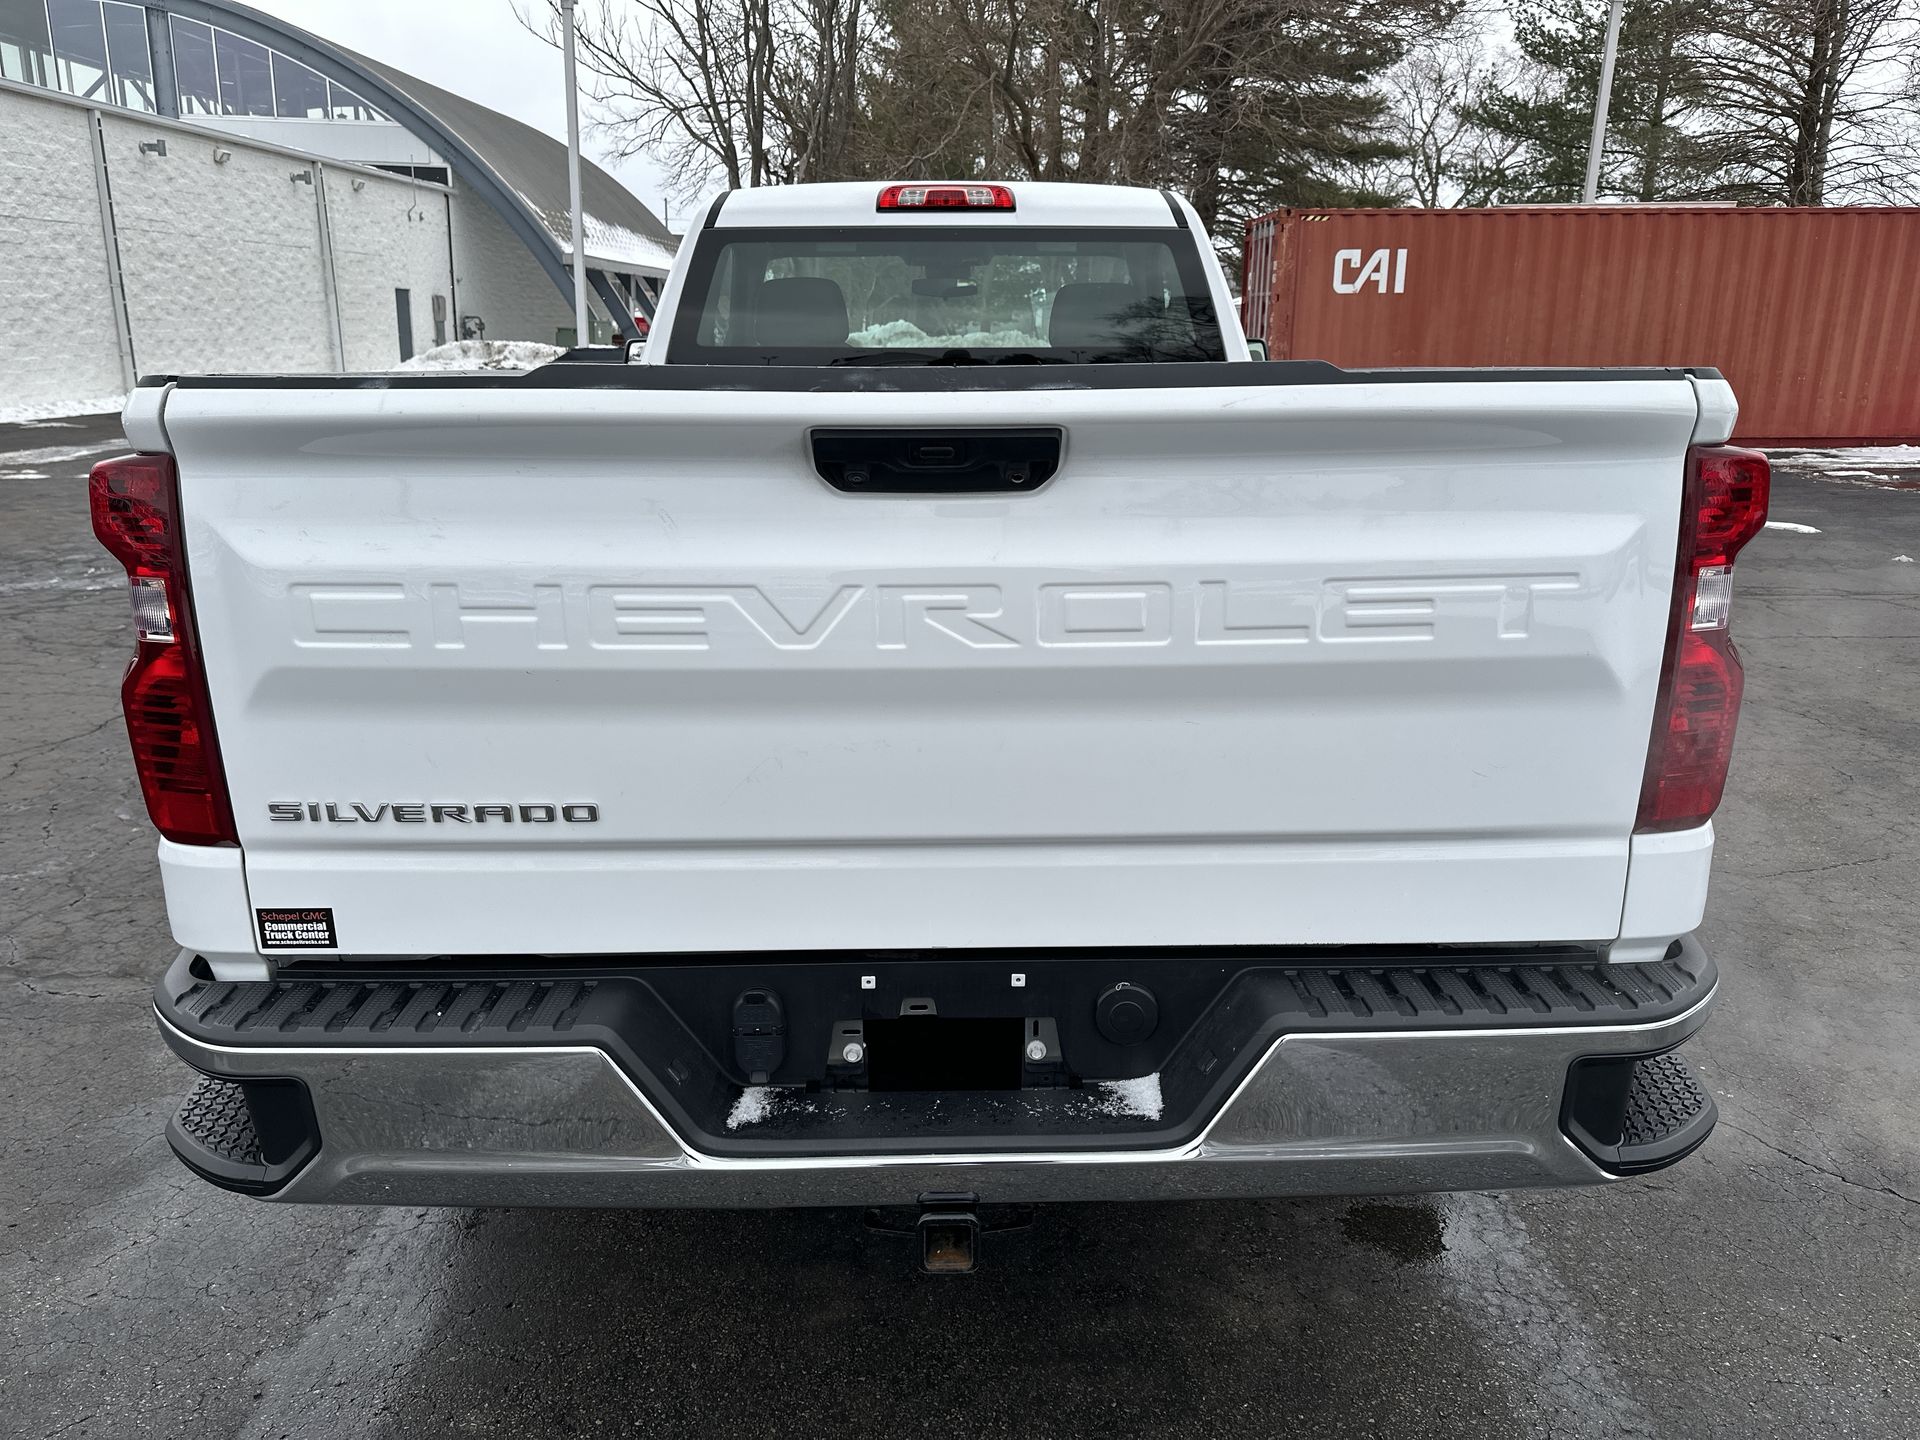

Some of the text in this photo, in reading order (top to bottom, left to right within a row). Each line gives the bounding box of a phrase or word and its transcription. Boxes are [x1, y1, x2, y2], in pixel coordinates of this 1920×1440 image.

[1333, 249, 1408, 294] CAI
[289, 572, 1581, 651] CHEVROLET
[268, 801, 600, 824] SILVERADO
[261, 911, 327, 921] Schepel GMC
[264, 922, 327, 931] Commercial
[264, 930, 330, 940] Truck Center
